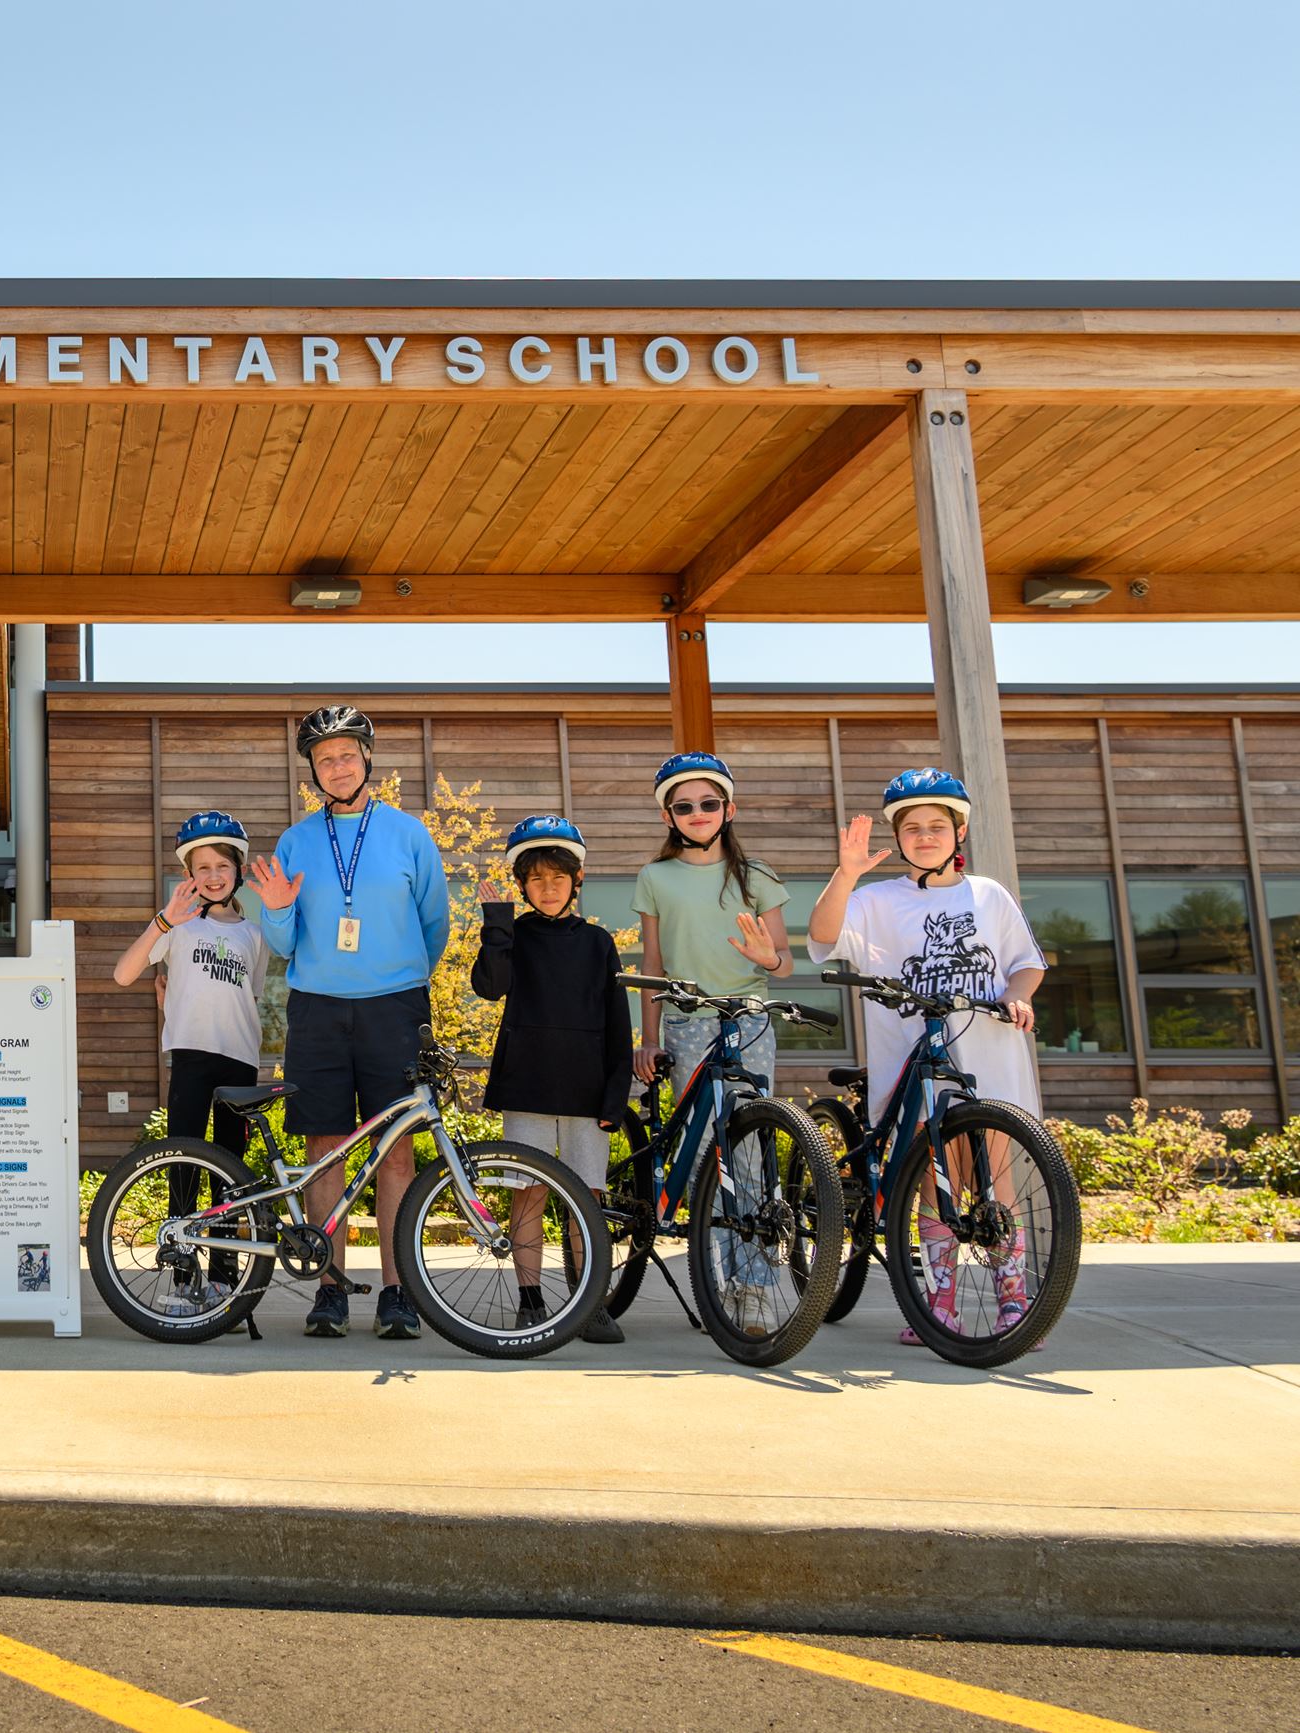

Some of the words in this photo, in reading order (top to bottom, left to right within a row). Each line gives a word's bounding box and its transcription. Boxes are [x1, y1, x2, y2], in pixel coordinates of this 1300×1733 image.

[444, 336, 820, 385] SCHOOL
[198, 938, 217, 950] Frog
[210, 965, 243, 988] NINJA
[922, 966, 982, 980] HARTFORD
[950, 972, 996, 1002] PACK
[136, 1150, 184, 1168] KENDA
[498, 1329, 555, 1346] KENDA
